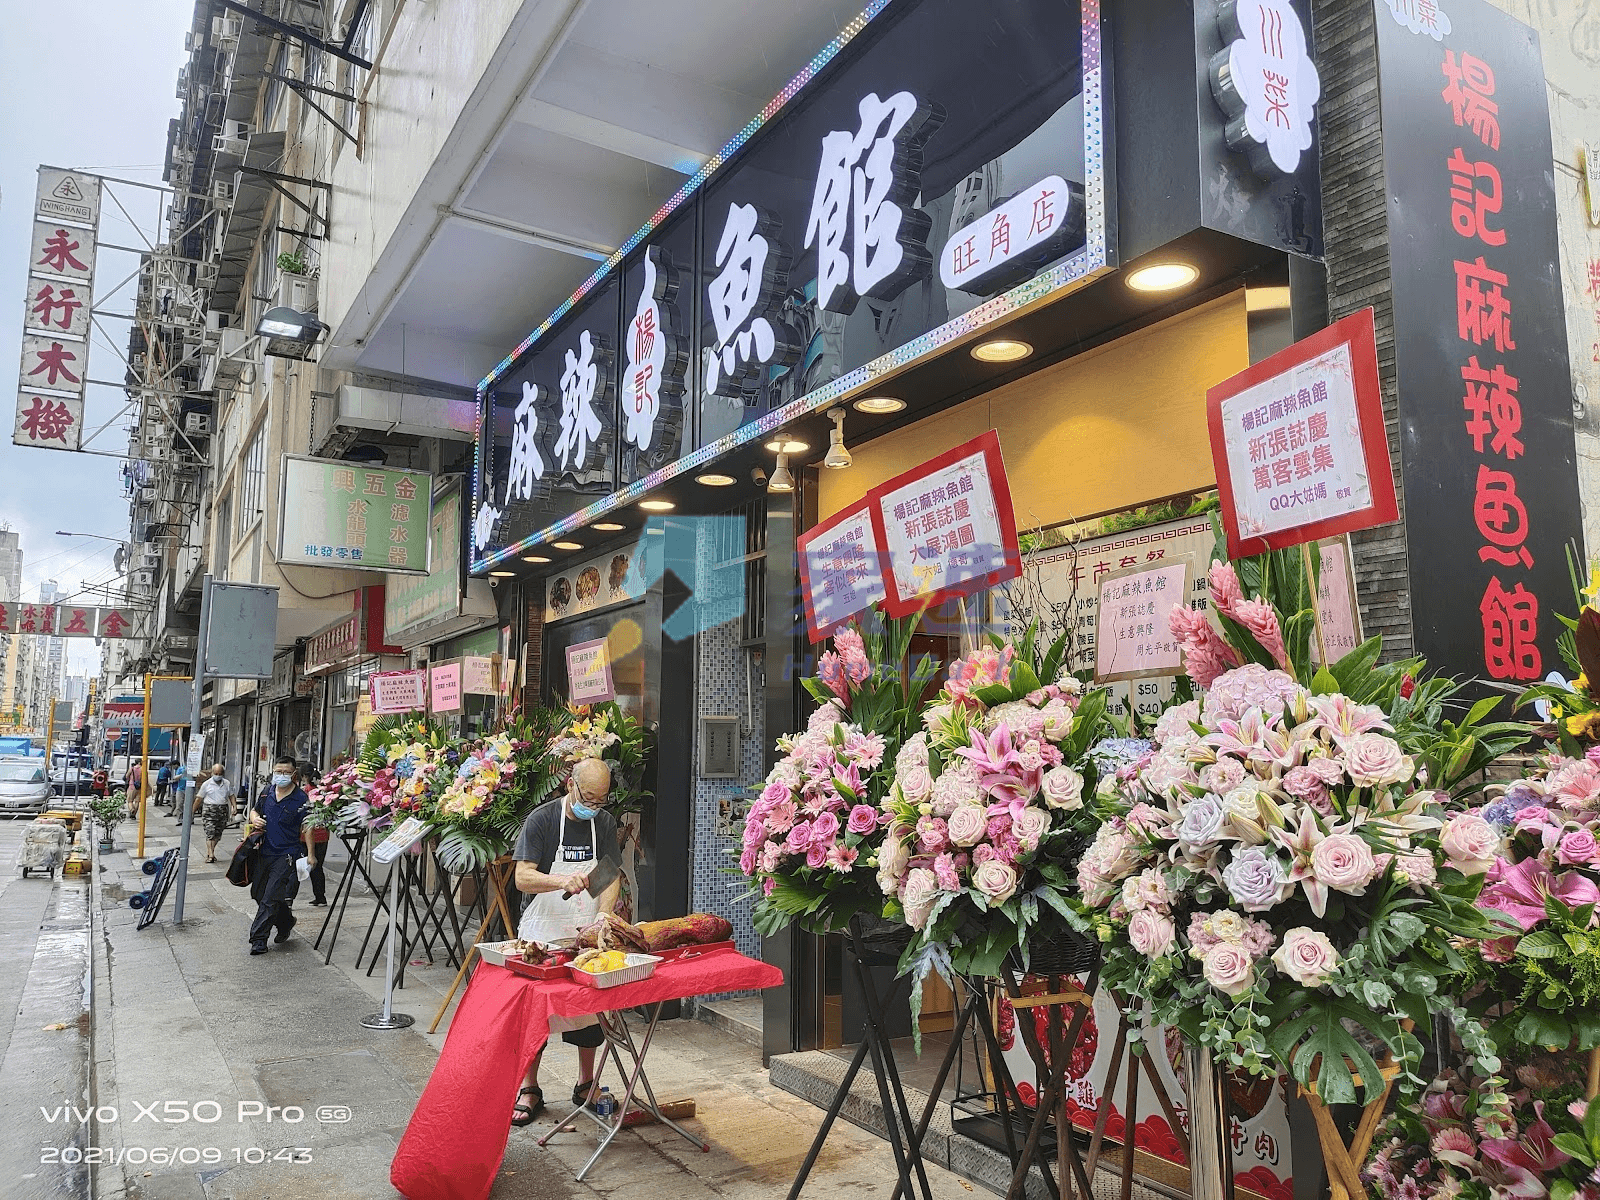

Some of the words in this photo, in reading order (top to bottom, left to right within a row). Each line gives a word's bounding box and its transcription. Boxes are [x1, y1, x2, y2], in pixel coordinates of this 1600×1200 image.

[60, 182, 78, 197] 永
[42, 201, 89, 217] WINGHANG
[952, 187, 1056, 278] 旺角店
[21, 229, 89, 443] 永行木機
[1441, 48, 1542, 680] 楊記麻辣魚館
[1242, 380, 1328, 432] 楊記麻辣魚館
[1248, 411, 1330, 464] 新張誌慶
[1252, 444, 1335, 493] 萬客雲集
[893, 474, 975, 521] 楊記麻辣魚館
[1269, 481, 1327, 511] QQ大姑媽
[388, 503, 409, 566] 濾水器
[904, 498, 971, 540] 新張誌慶
[304, 544, 364, 560] 批發零售
[817, 525, 865, 561] 楊記麻辣魚館
[909, 523, 976, 564] 大展鴻圖
[821, 544, 866, 580] 生意興隆
[823, 563, 869, 598] 客似雲來
[1103, 575, 1167, 603] 楊記麻辣魚館
[1119, 605, 1155, 619] 新張誌慶
[1118, 624, 1155, 640] 生意興隆
[1138, 684, 1158, 695] $50
[1138, 703, 1159, 715] $40
